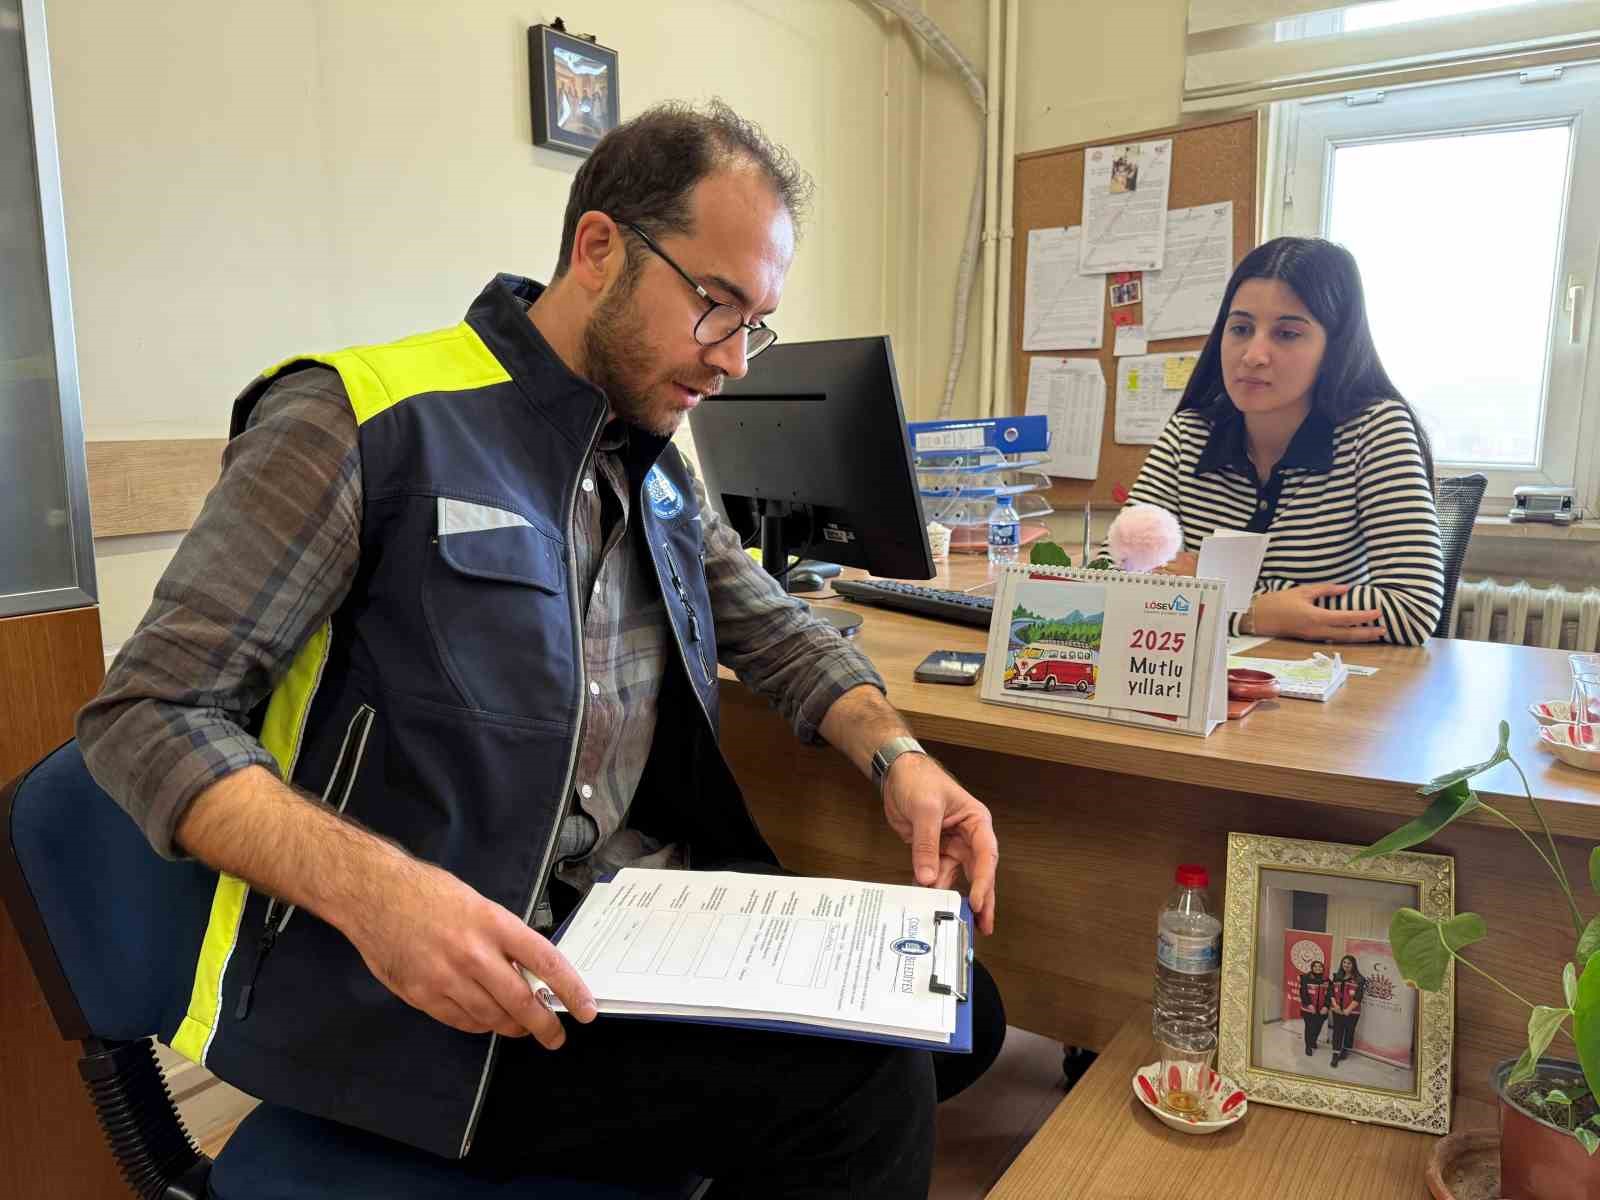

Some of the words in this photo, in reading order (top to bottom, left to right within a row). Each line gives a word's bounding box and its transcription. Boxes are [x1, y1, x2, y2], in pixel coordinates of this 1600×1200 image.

[1129, 629, 1186, 652] 2025
[1130, 656, 1183, 678] Mutlu
[1128, 678, 1181, 698] yıllar!
